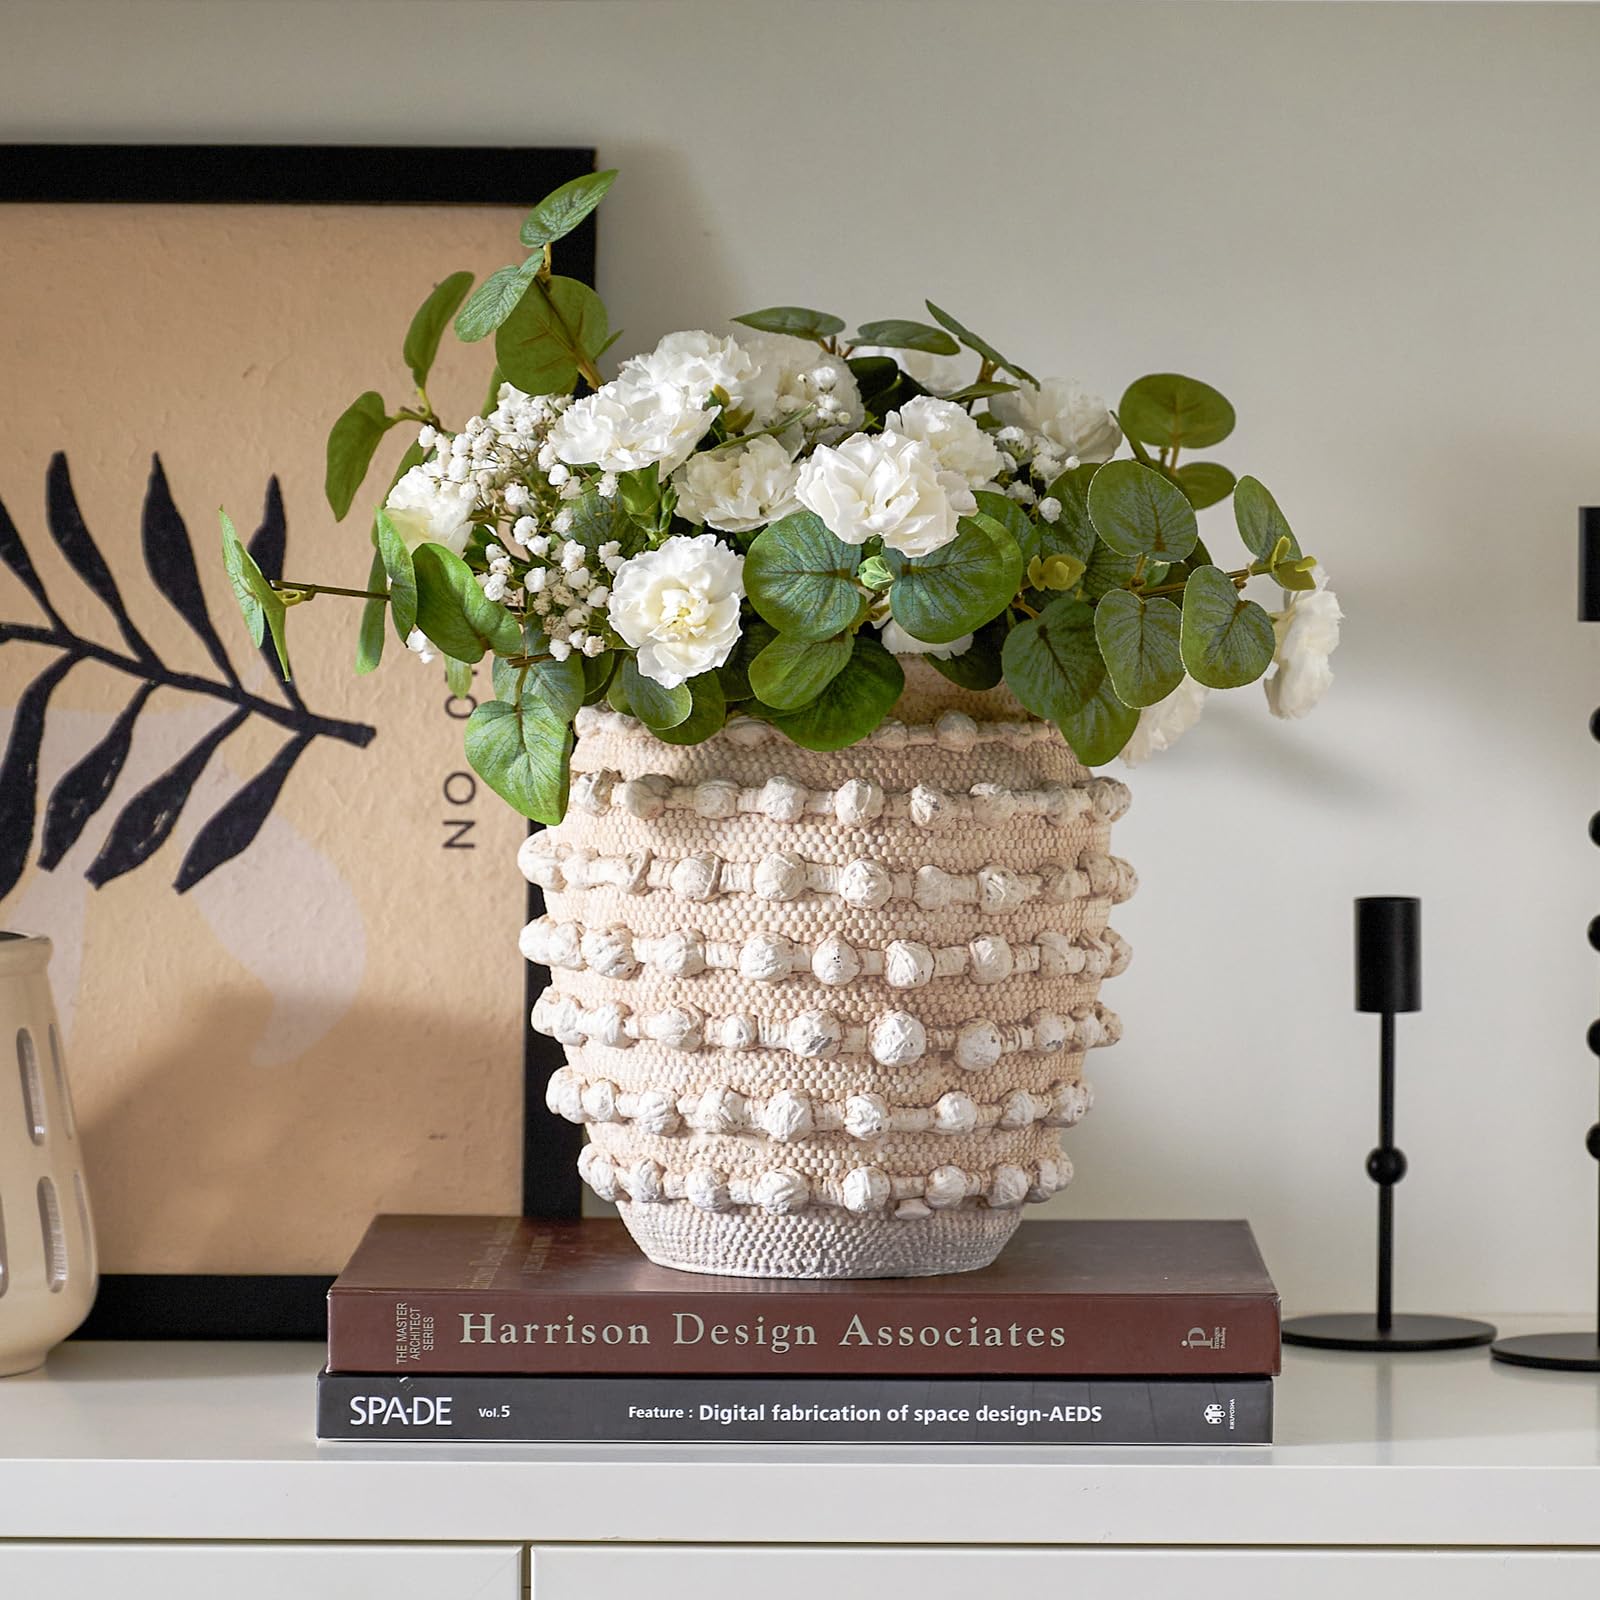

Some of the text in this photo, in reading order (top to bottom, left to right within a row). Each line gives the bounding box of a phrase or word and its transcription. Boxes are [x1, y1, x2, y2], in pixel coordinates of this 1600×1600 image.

[442, 771, 477, 850] NO
[396, 1302, 408, 1366] THE MASTER
[409, 1307, 422, 1361] ARCHITECT
[423, 1316, 434, 1352] SERIES
[458, 1312, 1066, 1354] Harrison Design Associates
[628, 1406, 684, 1419] Feature
[699, 1403, 765, 1425] Digital
[771, 1403, 881, 1422] fabrication
[886, 1403, 909, 1422] of
[913, 1408, 970, 1426] space
[975, 1403, 1103, 1426] design-AEDS
